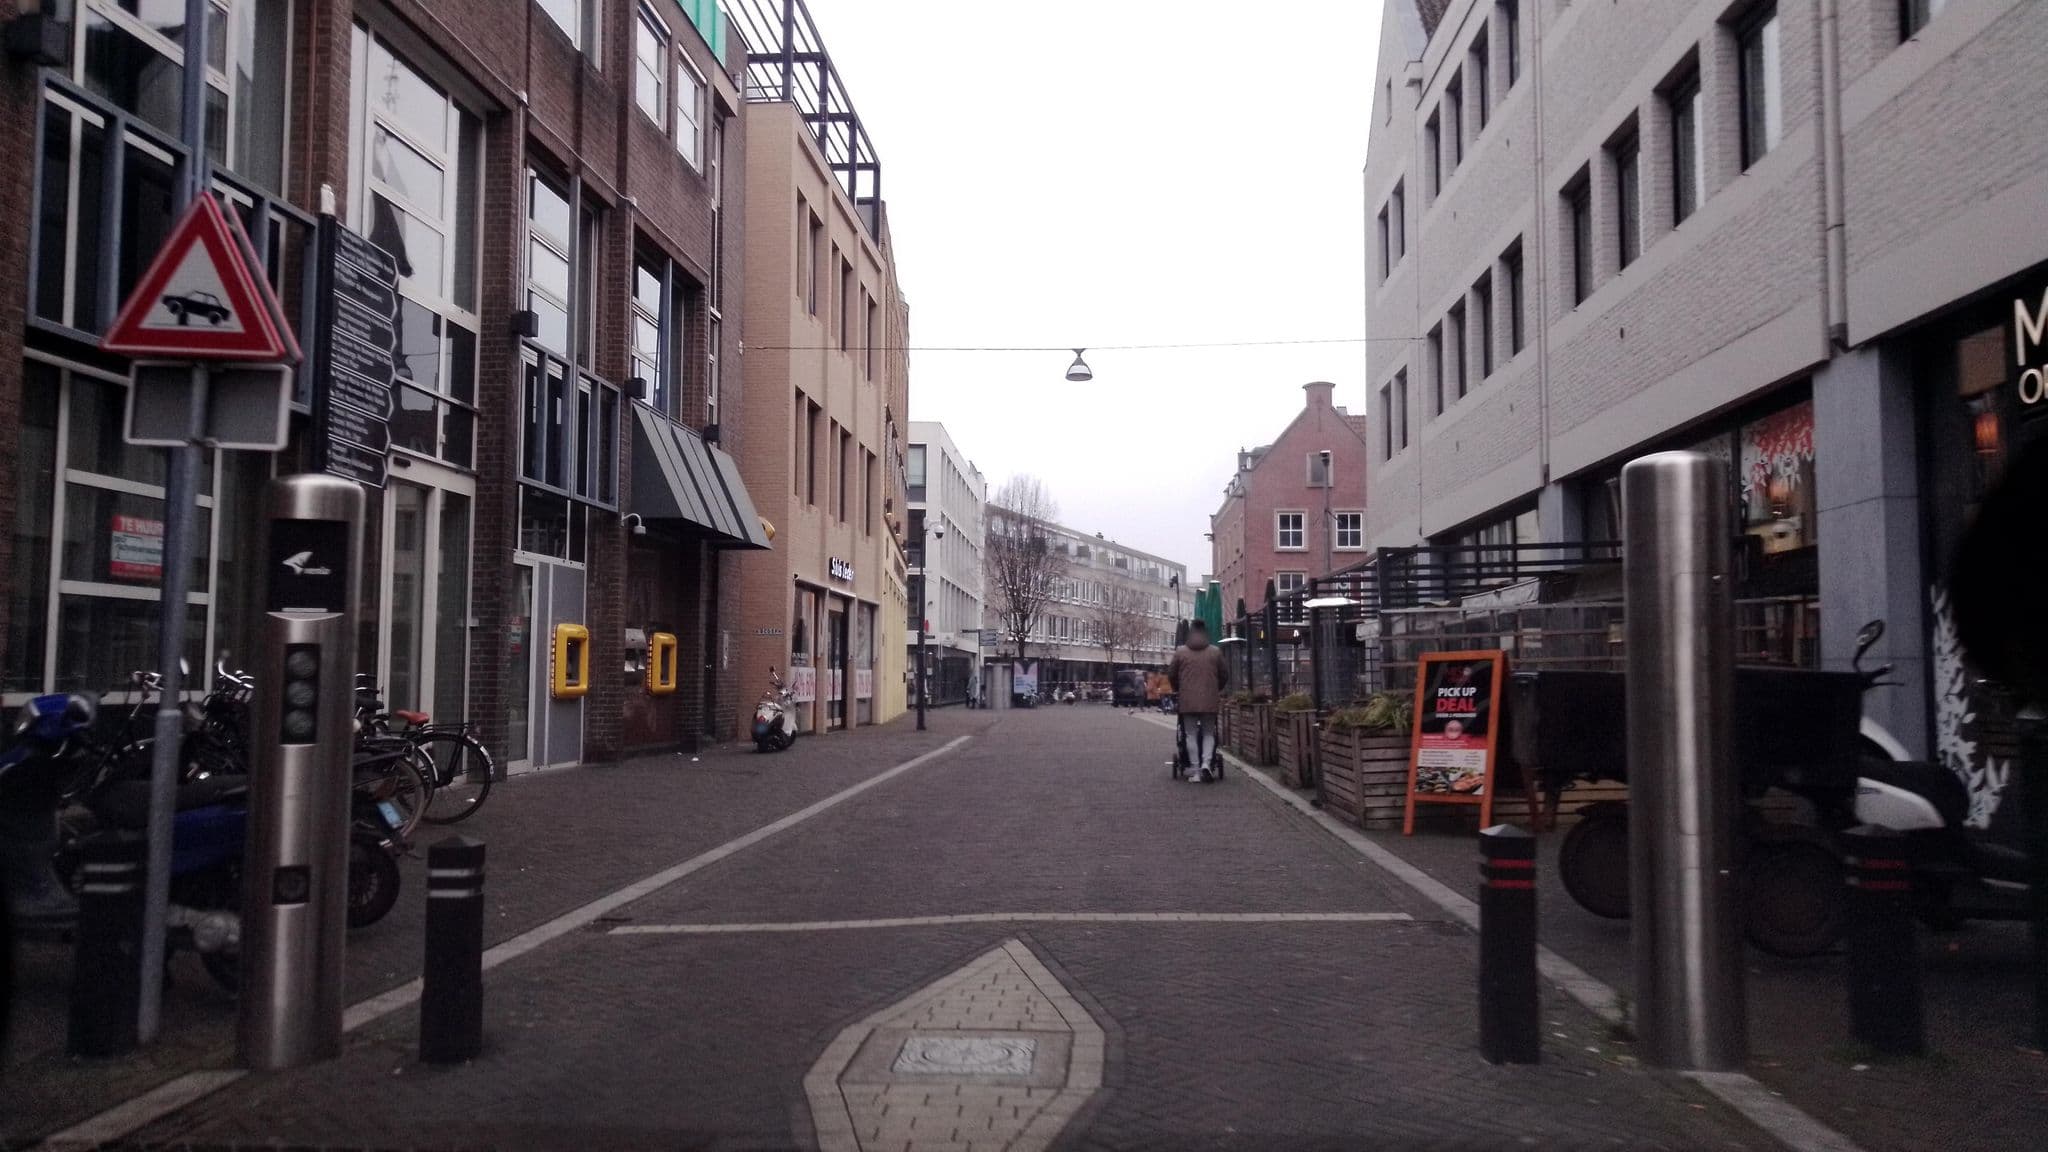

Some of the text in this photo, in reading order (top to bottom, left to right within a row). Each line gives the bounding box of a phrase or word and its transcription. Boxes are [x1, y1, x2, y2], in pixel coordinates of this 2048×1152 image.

[121, 516, 136, 531] TE
[1438, 687, 1477, 697] PICK UP
[1436, 698, 1476, 712] DEAL
